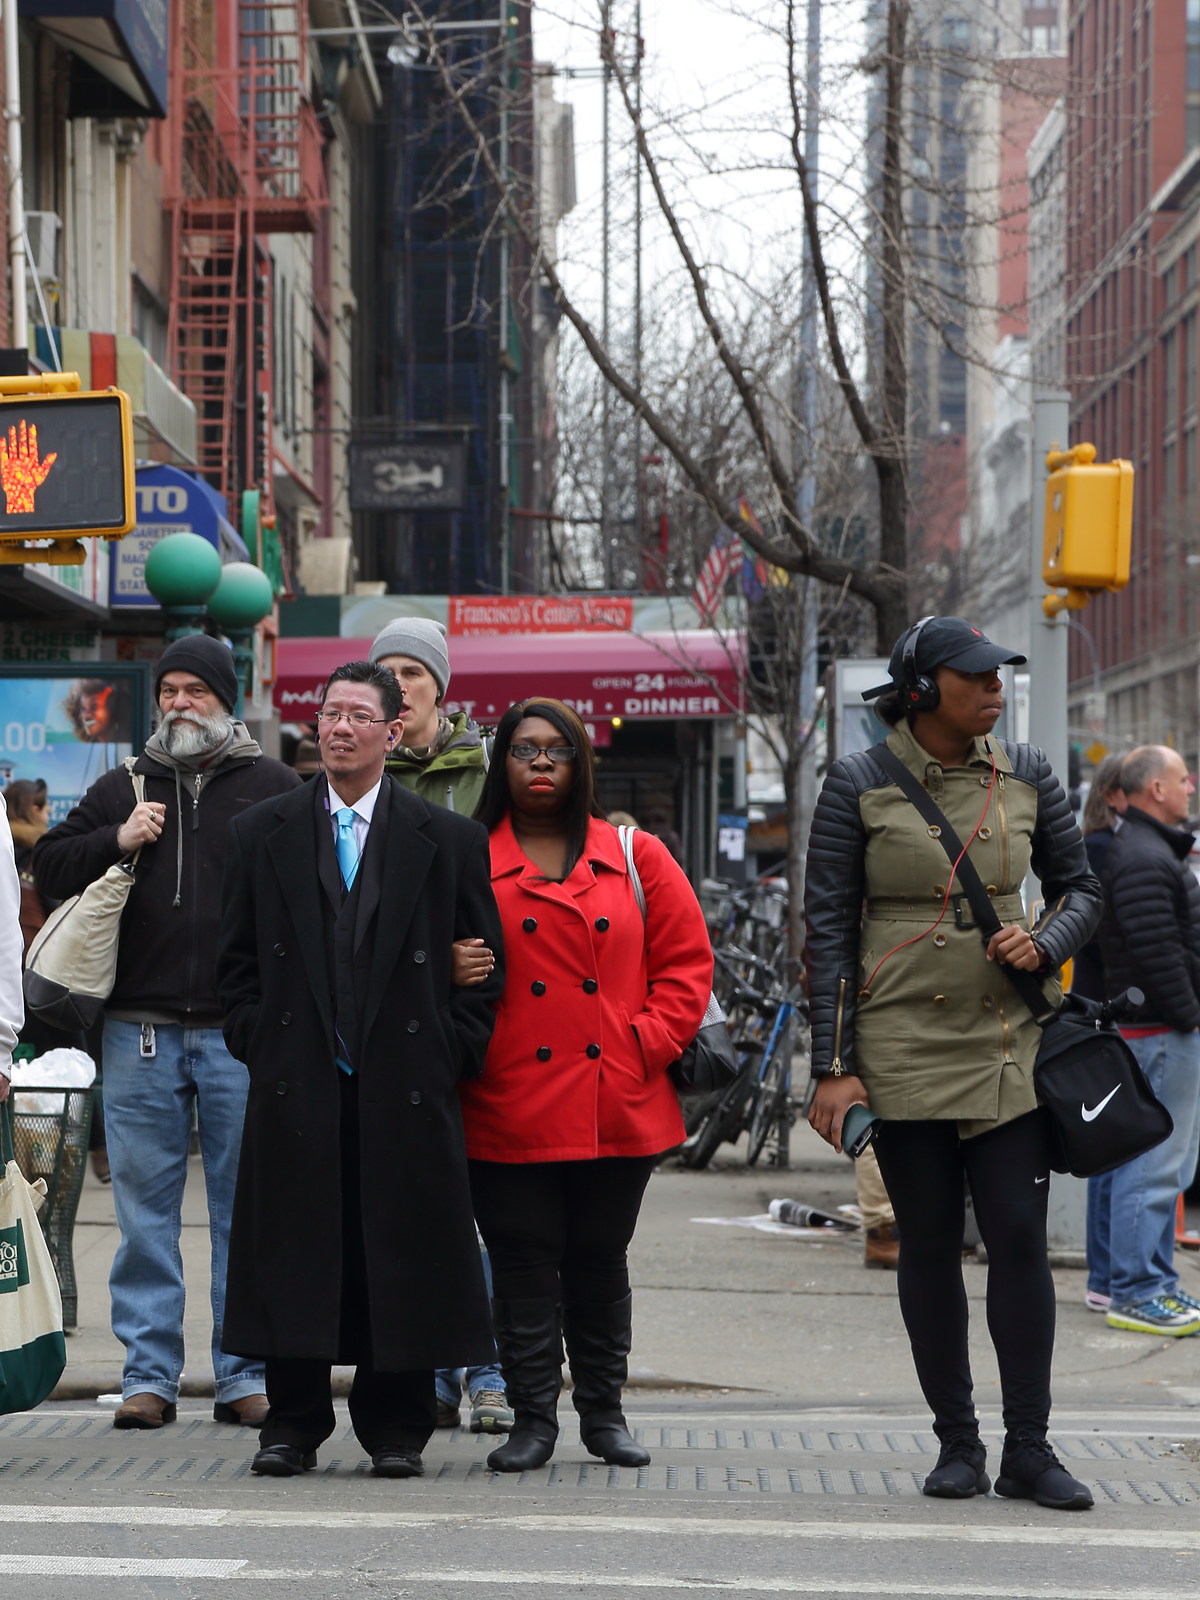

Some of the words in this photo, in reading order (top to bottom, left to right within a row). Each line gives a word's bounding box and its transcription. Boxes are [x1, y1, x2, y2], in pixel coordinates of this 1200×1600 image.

[3, 630, 14, 644] 2
[20, 631, 95, 648] CHEESE
[3, 648, 71, 661] SLICES
[592, 678, 632, 689] OPEN
[634, 674, 666, 692] 24
[625, 697, 720, 714] DINNER
